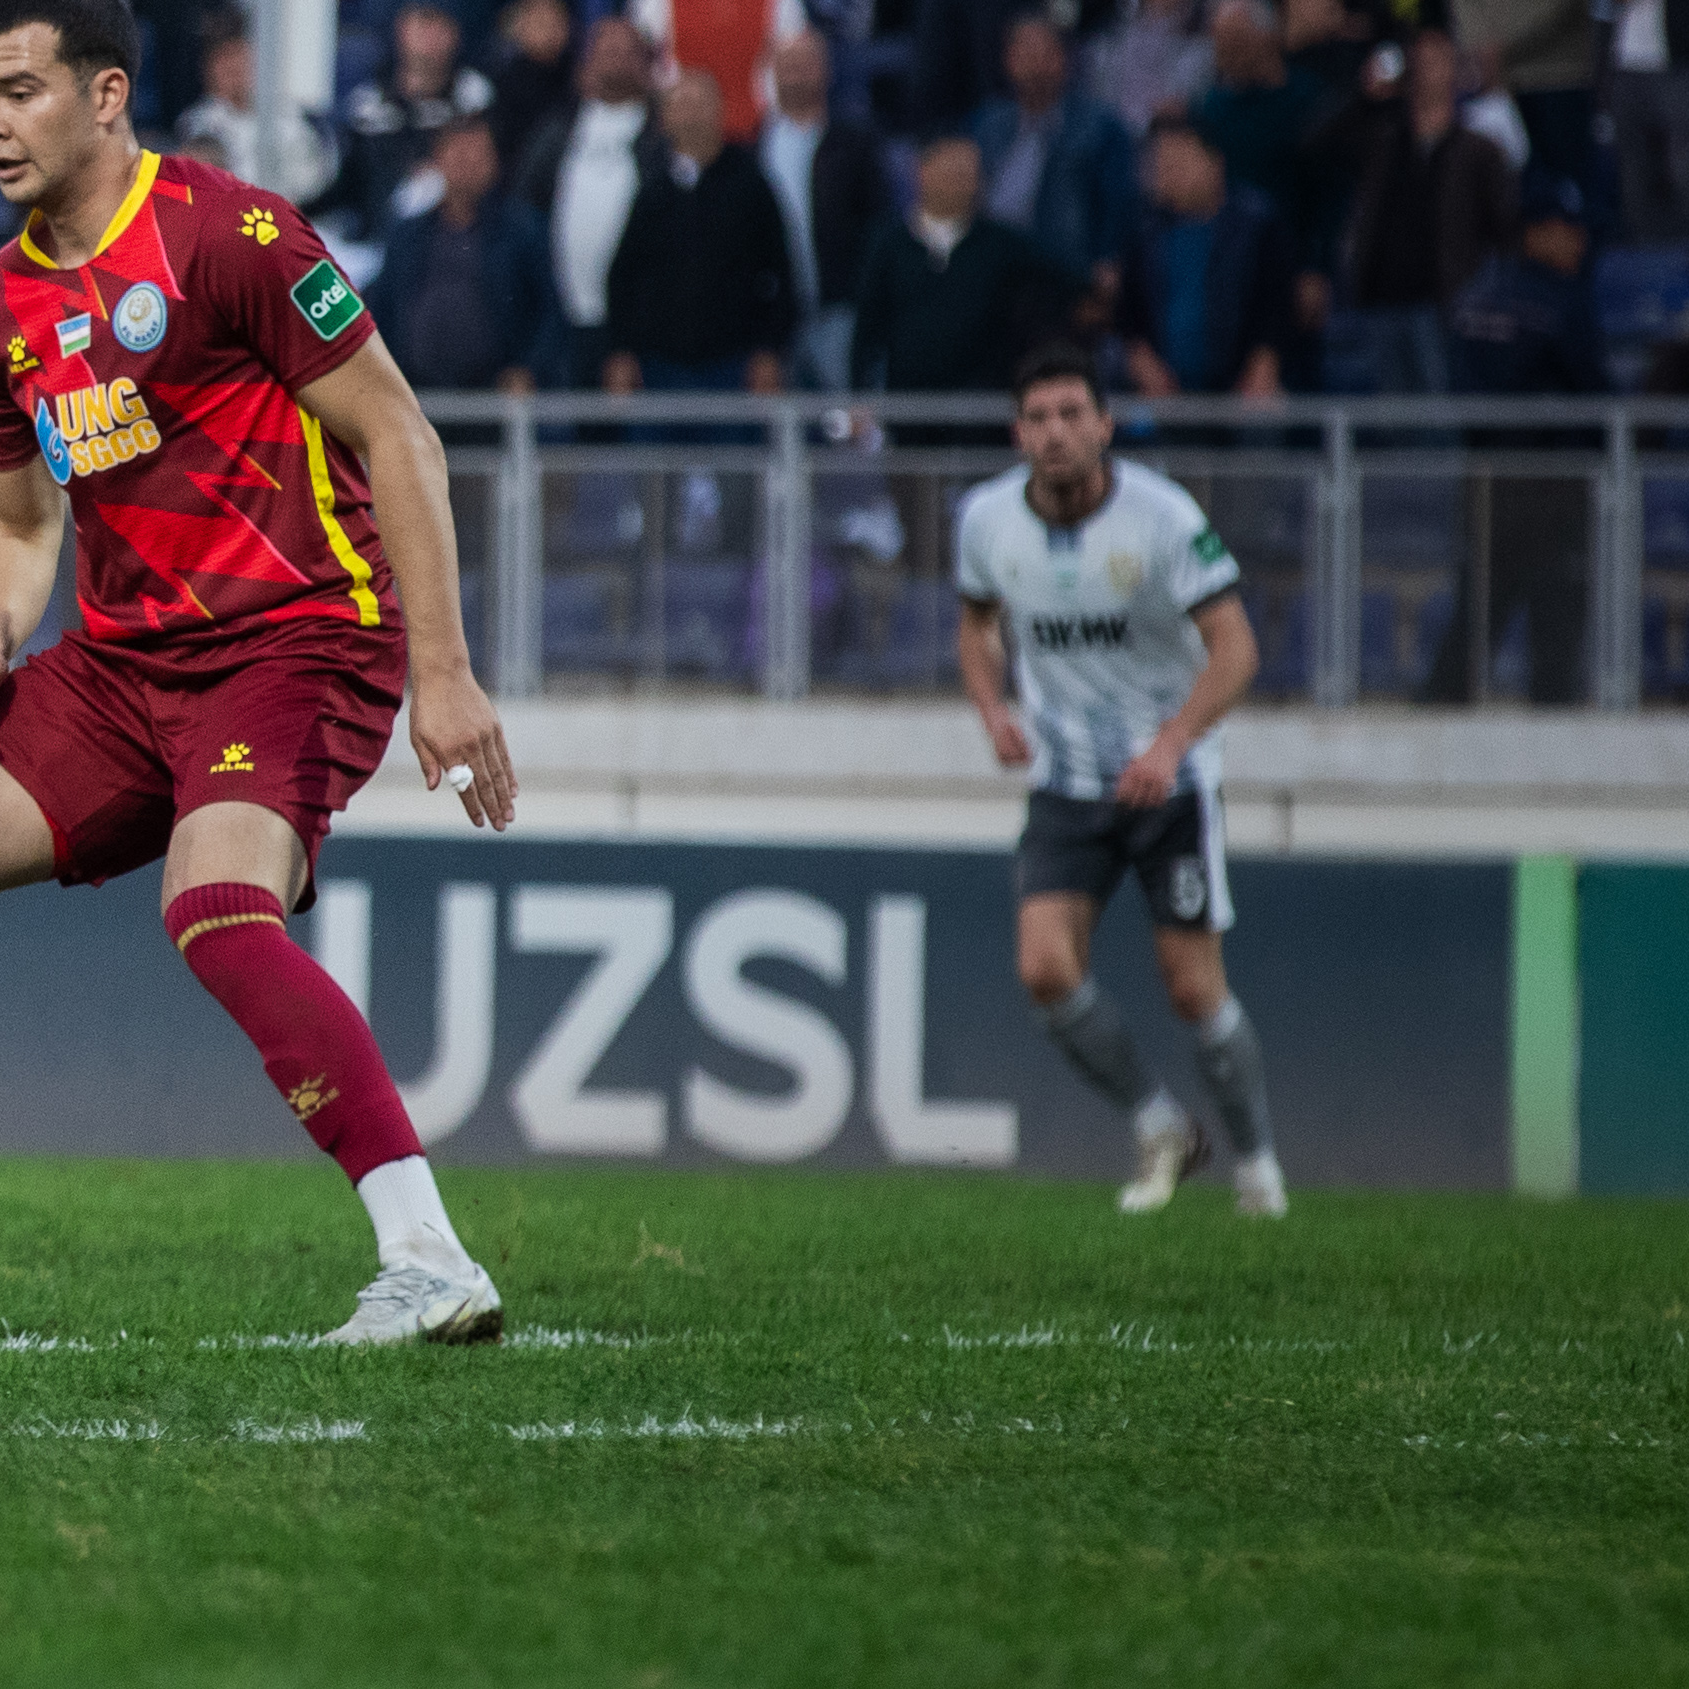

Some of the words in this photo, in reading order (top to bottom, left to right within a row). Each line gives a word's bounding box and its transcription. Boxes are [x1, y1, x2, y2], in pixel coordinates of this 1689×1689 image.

[309, 277, 348, 320] artel
[55, 376, 151, 442] UNG
[68, 418, 162, 477] SGCC
[209, 761, 255, 775] KELME
[312, 877, 1020, 1167] UZSL
